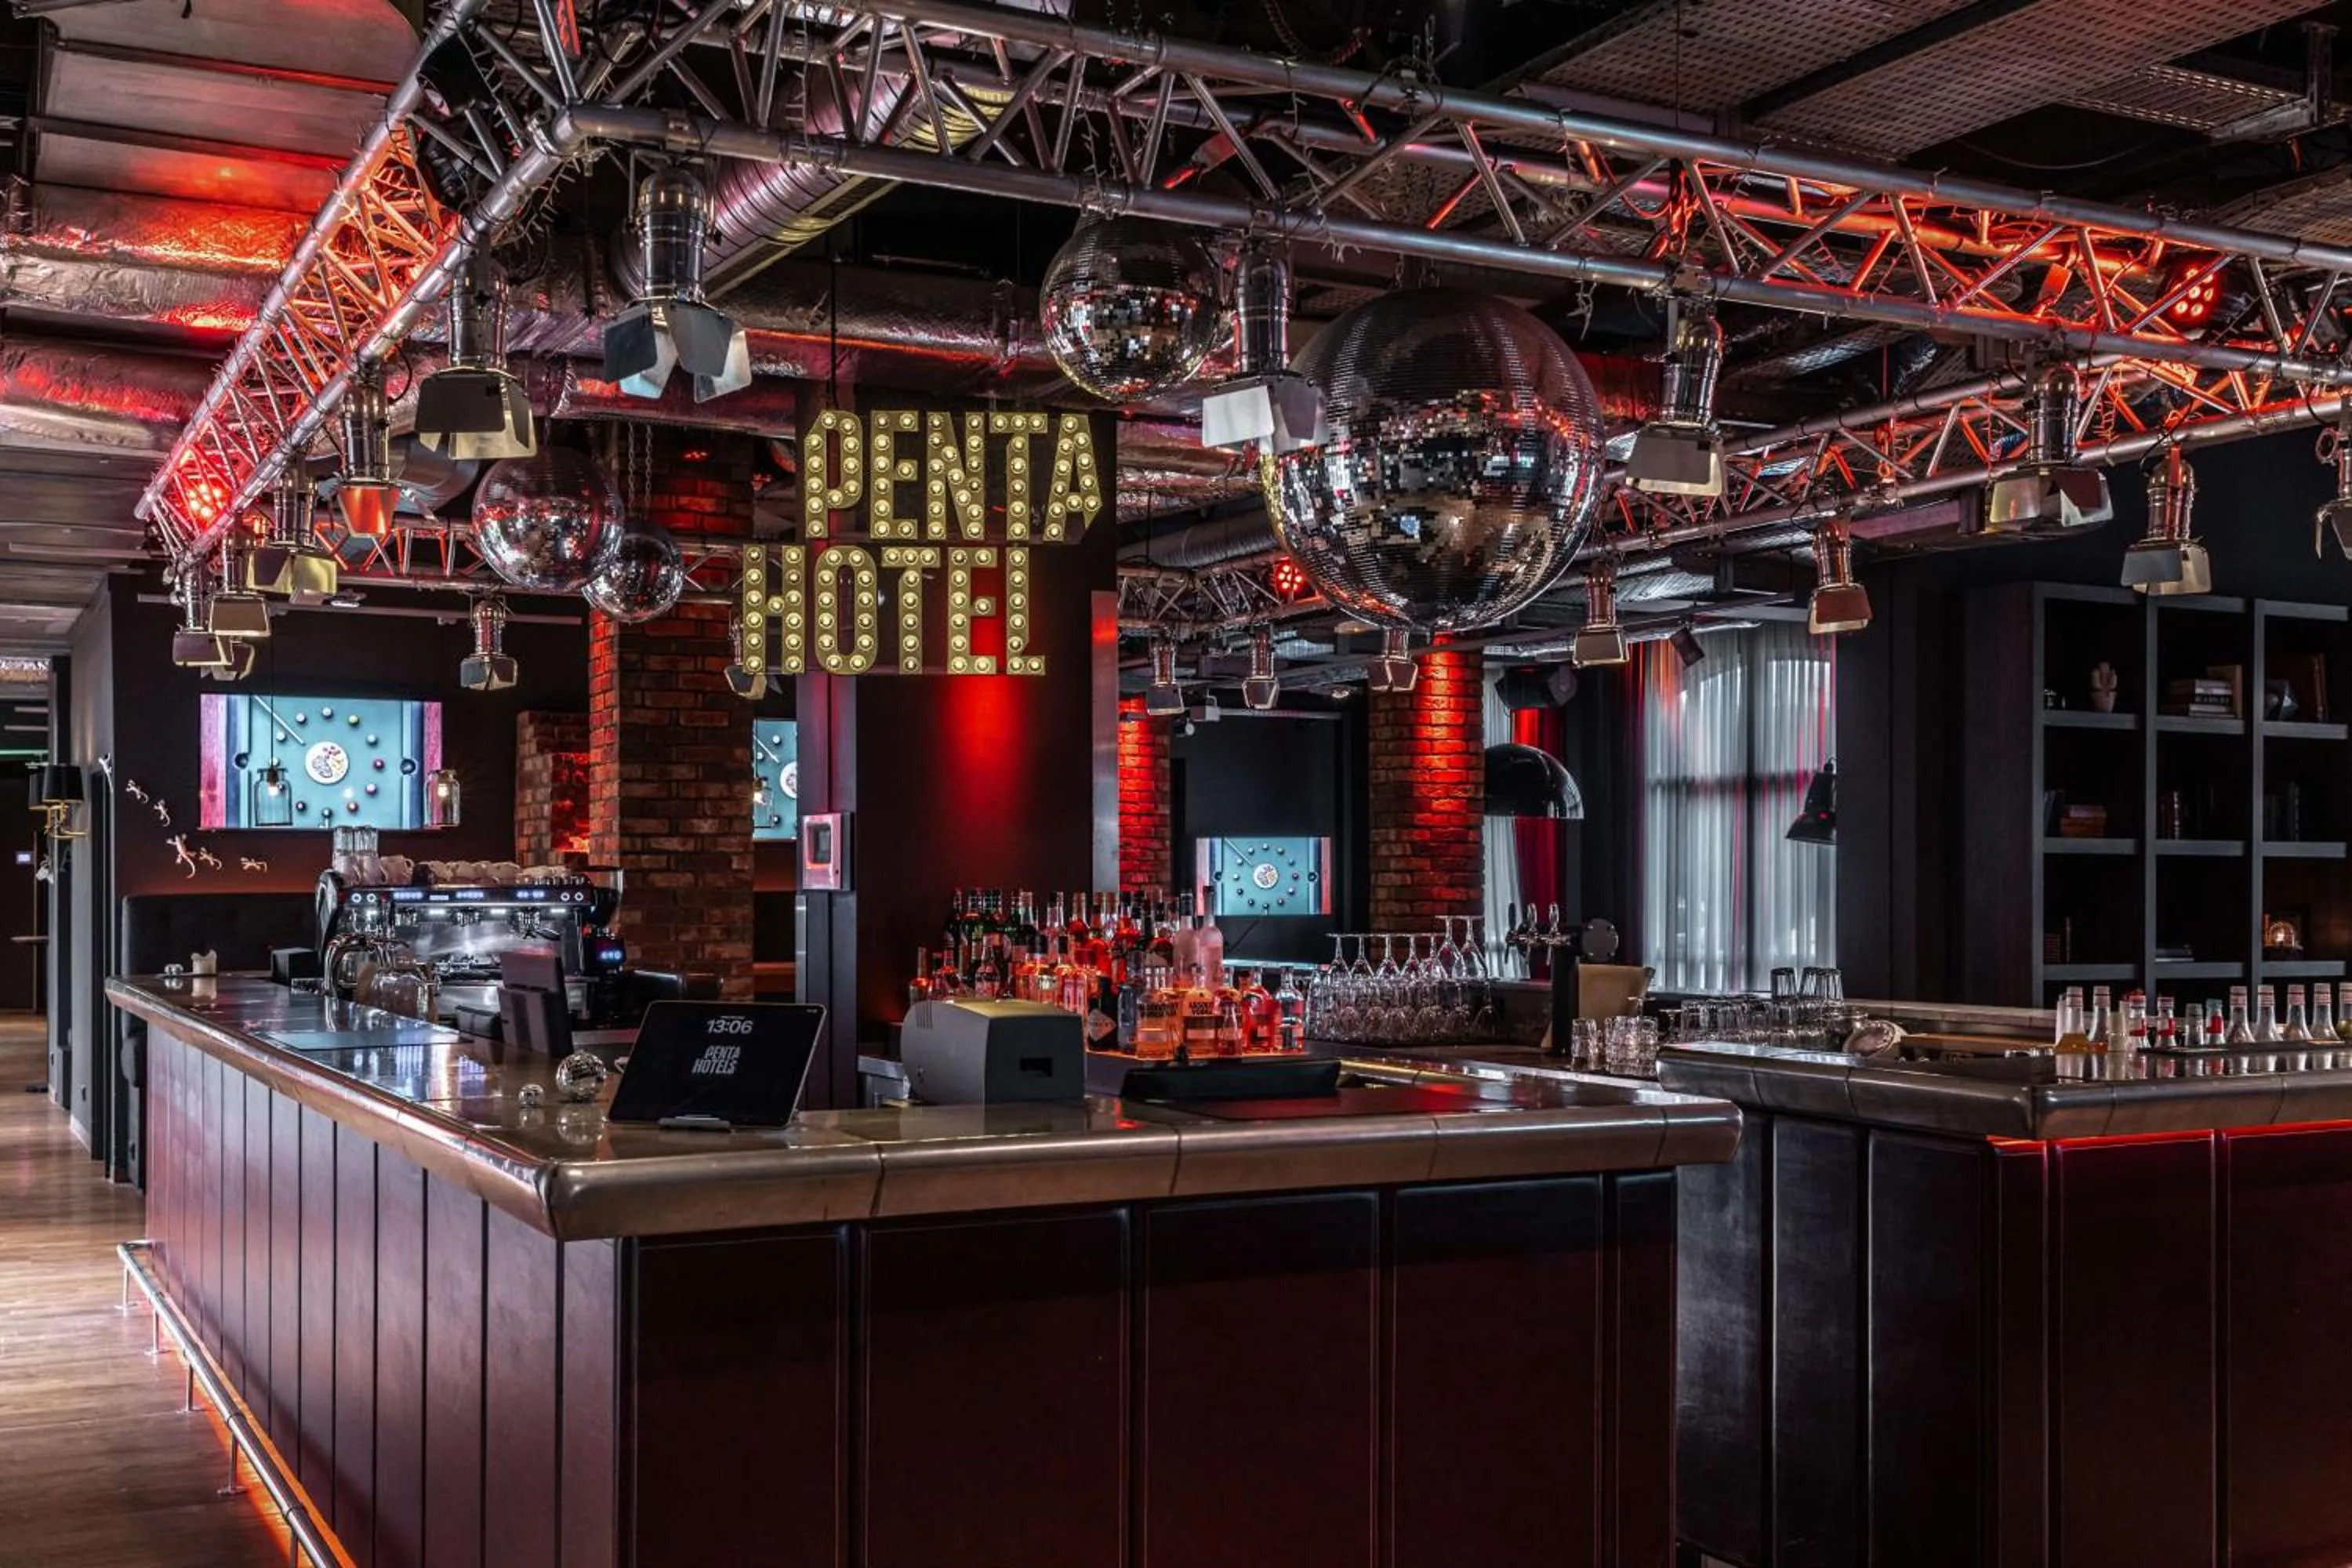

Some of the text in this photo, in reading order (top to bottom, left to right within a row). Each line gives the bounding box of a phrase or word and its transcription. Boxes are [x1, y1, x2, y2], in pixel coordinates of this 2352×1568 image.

[804, 409, 1102, 541] PENTA
[742, 545, 1046, 675] HOTEL
[707, 1019, 753, 1034] 13:06
[705, 1046, 740, 1058] PENTA
[692, 1058, 737, 1073] HOTELS
